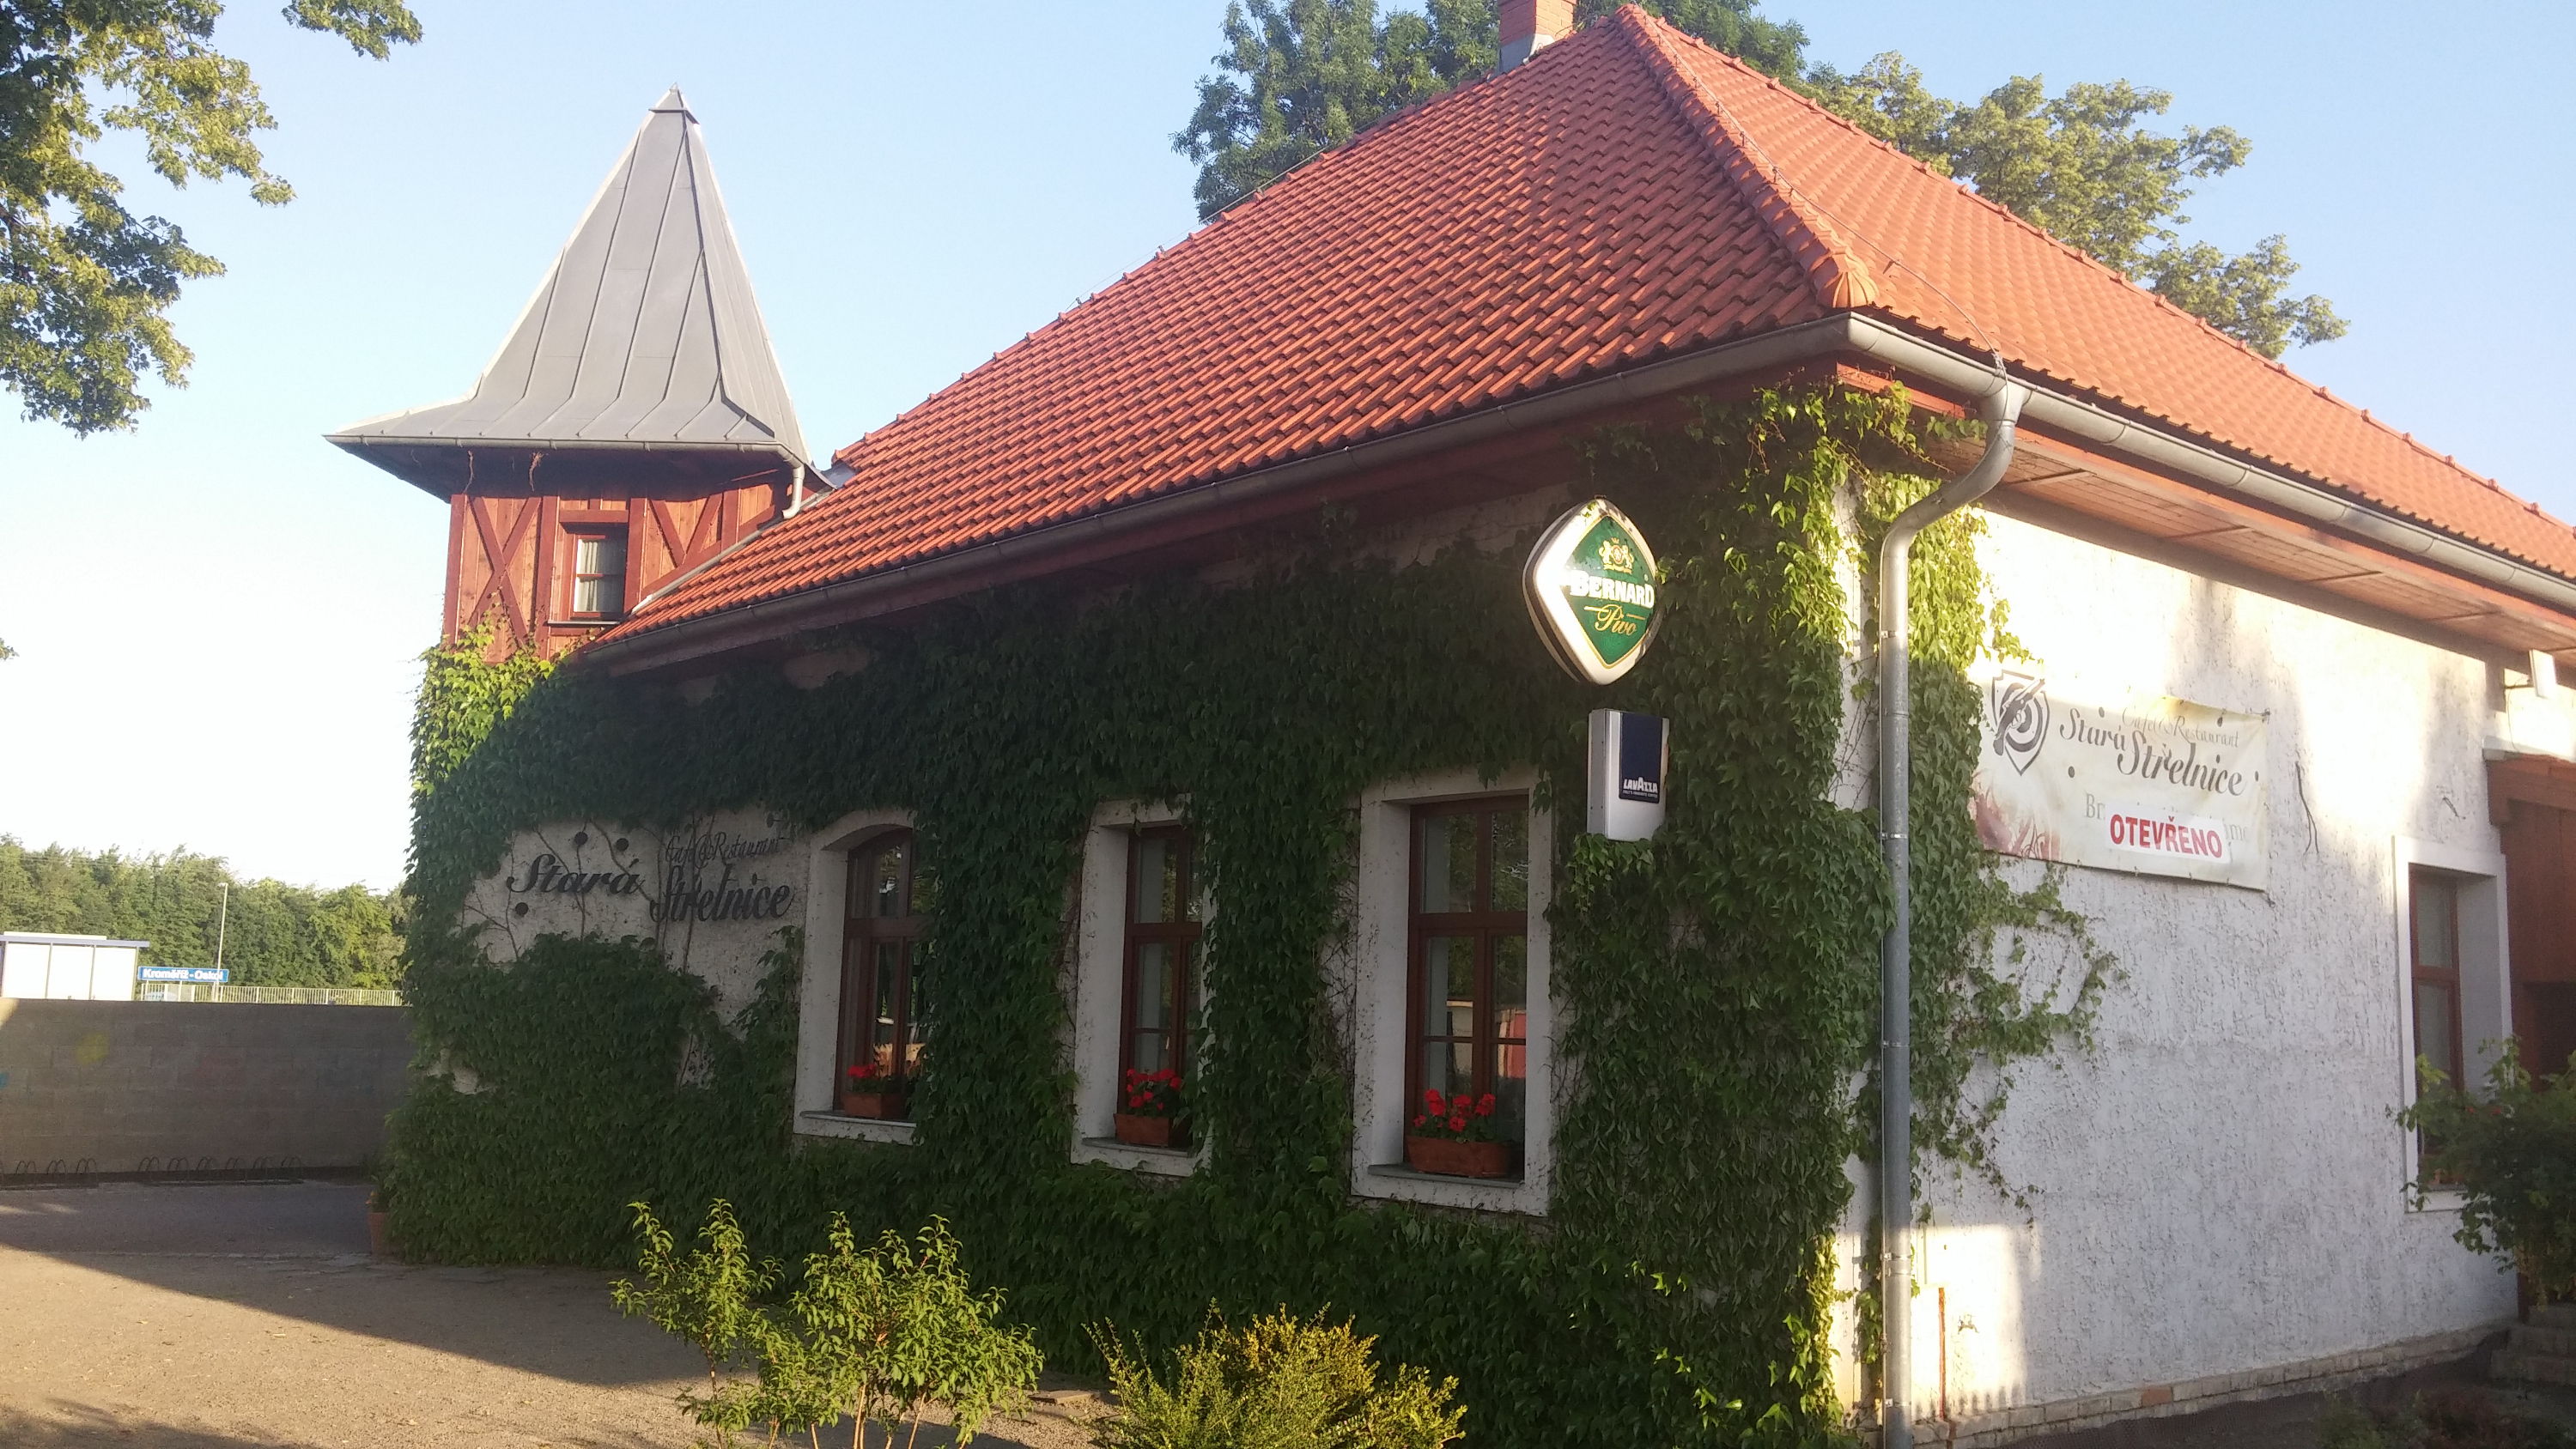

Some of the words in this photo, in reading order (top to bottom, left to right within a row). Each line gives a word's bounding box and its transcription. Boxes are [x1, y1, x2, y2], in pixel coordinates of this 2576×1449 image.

[1570, 570, 1655, 609] BERNARD
[1595, 604, 1637, 635] Pivo
[2173, 715, 2240, 749] Restaurant
[2059, 707, 2127, 752] Stará
[2117, 730, 2248, 797] Střelnice
[1623, 777, 1658, 793] LAVAZZA
[713, 831, 780, 866] Restaurant
[2110, 814, 2222, 858] OTEVŘENO
[506, 853, 646, 894] Stará
